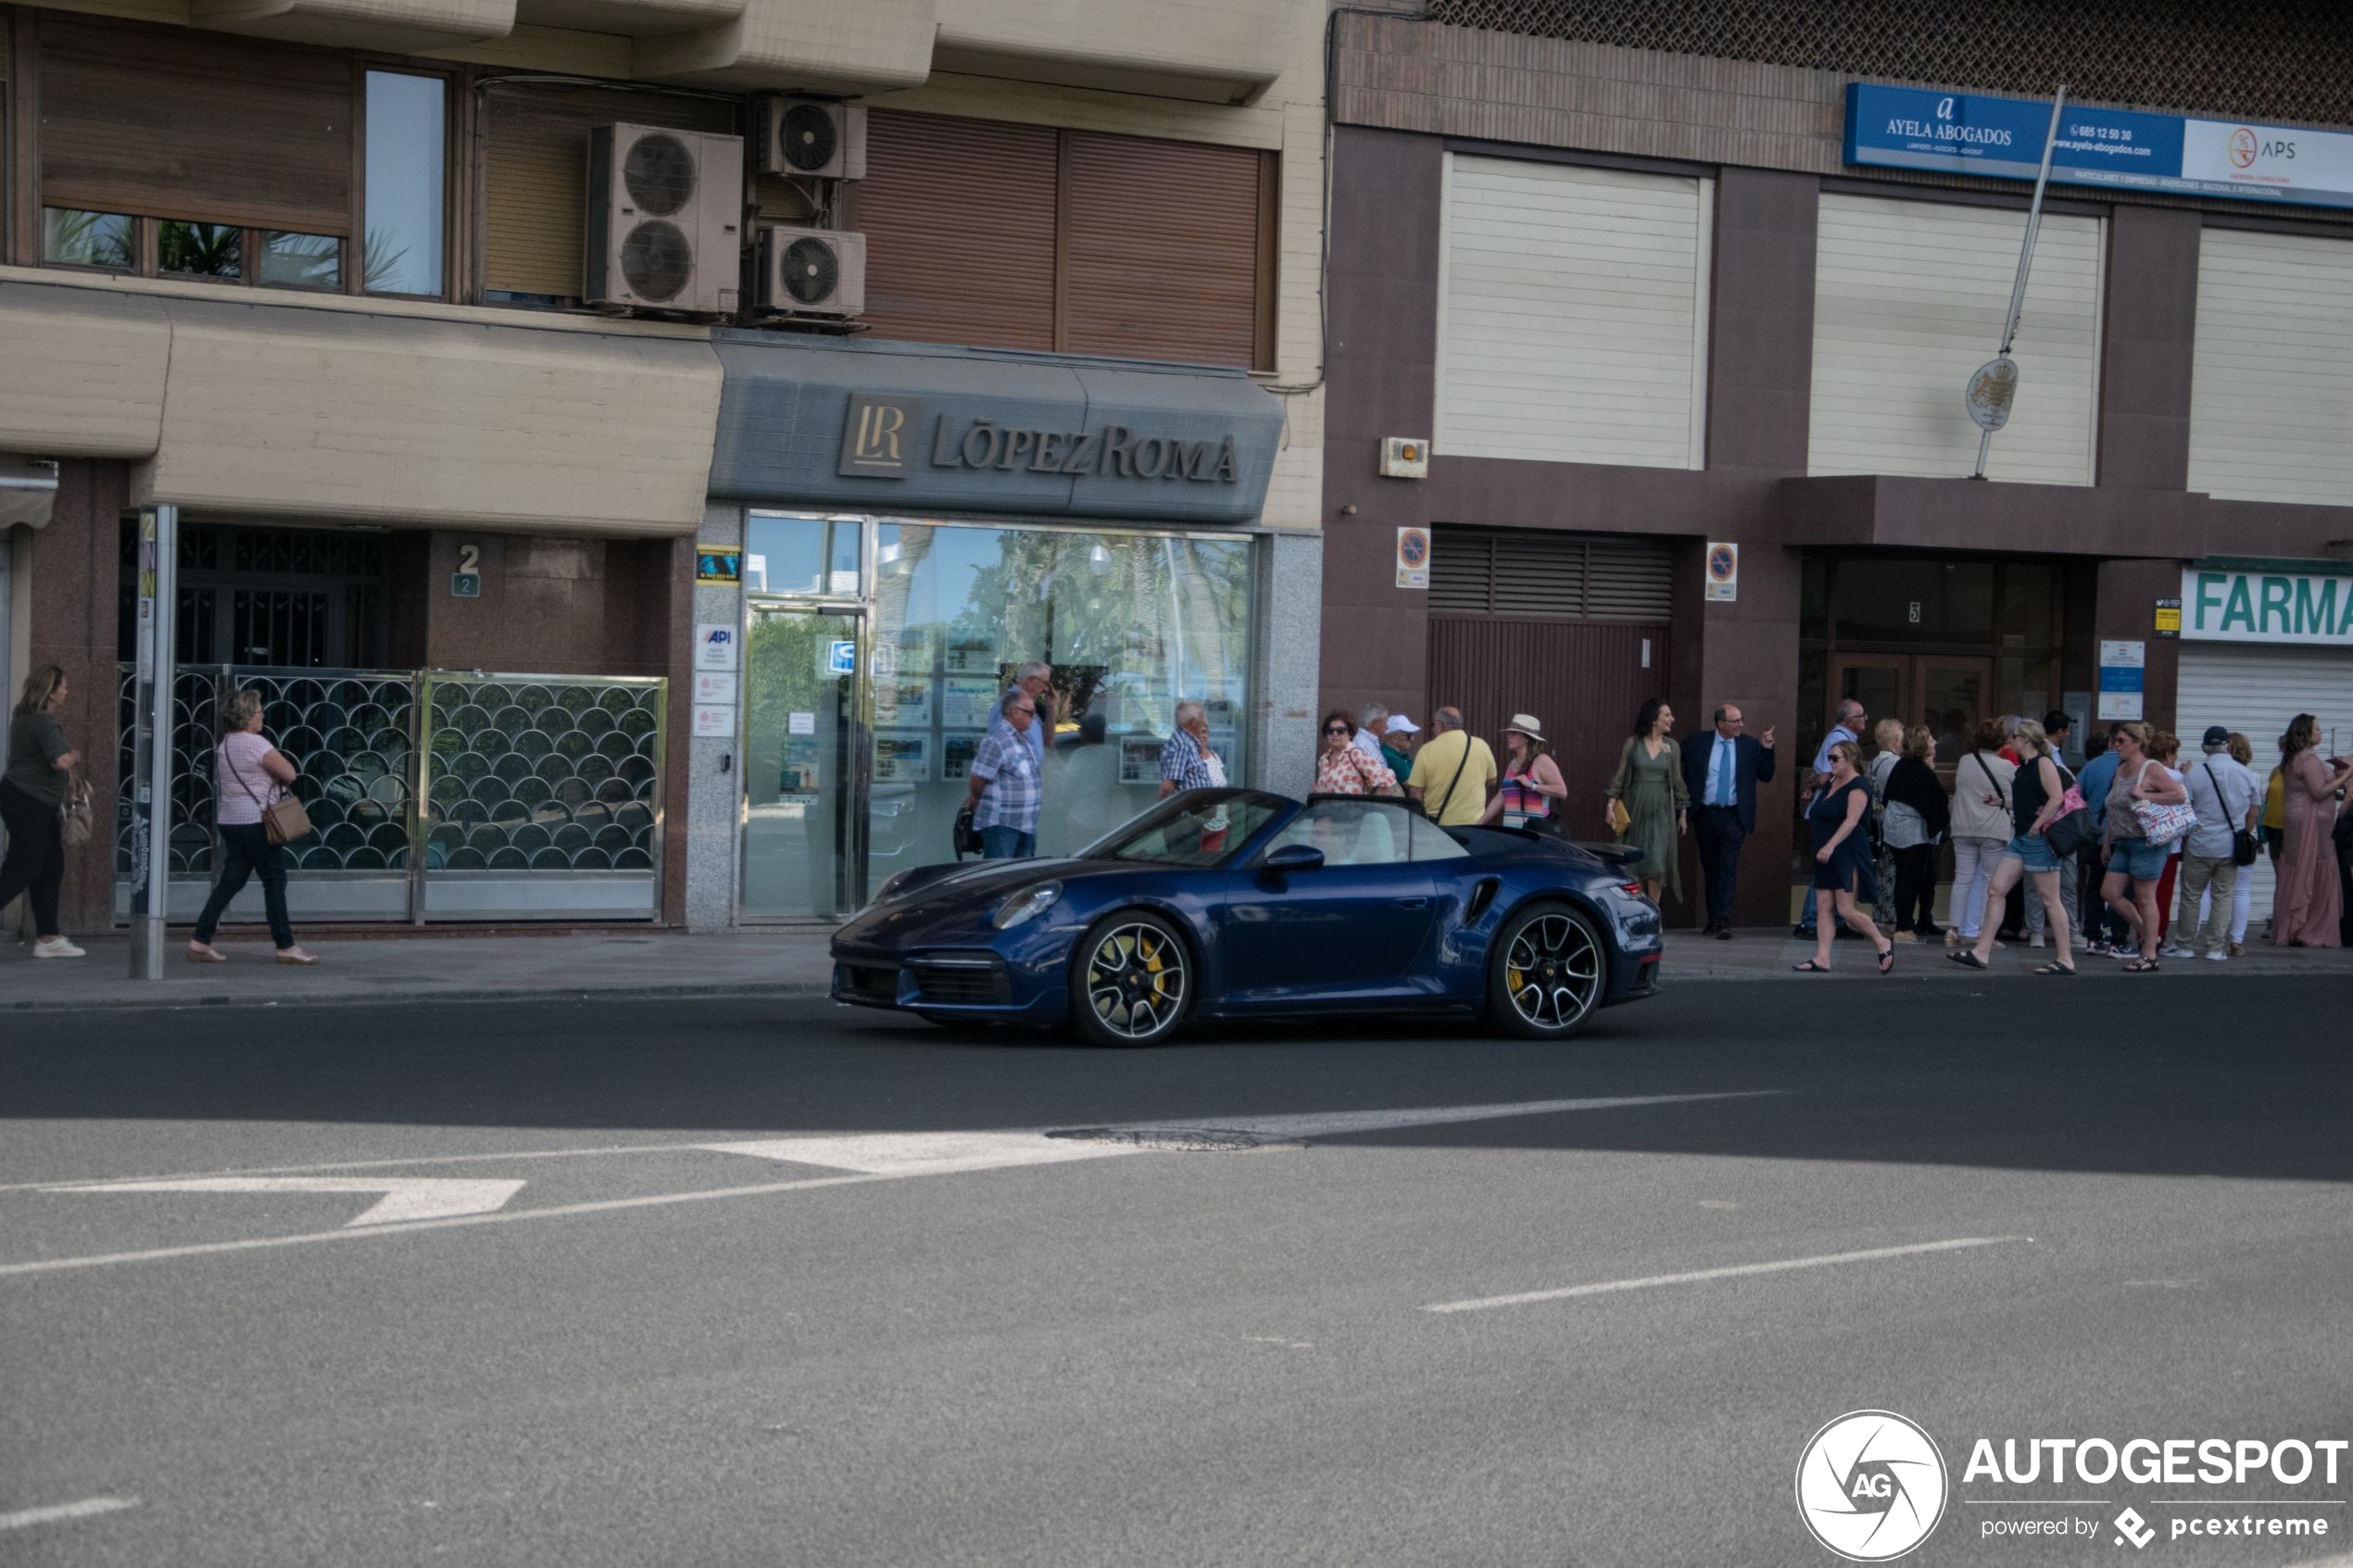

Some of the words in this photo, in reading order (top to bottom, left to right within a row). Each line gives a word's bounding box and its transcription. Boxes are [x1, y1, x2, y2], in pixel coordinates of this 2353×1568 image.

[1886, 119, 1932, 139] AYELA
[1934, 123, 2012, 146] ABOGADOS
[2097, 128, 2108, 139] 12
[2261, 141, 2296, 159] APS
[459, 544, 479, 574] 2
[462, 578, 471, 593] 2
[708, 630, 731, 645] API
